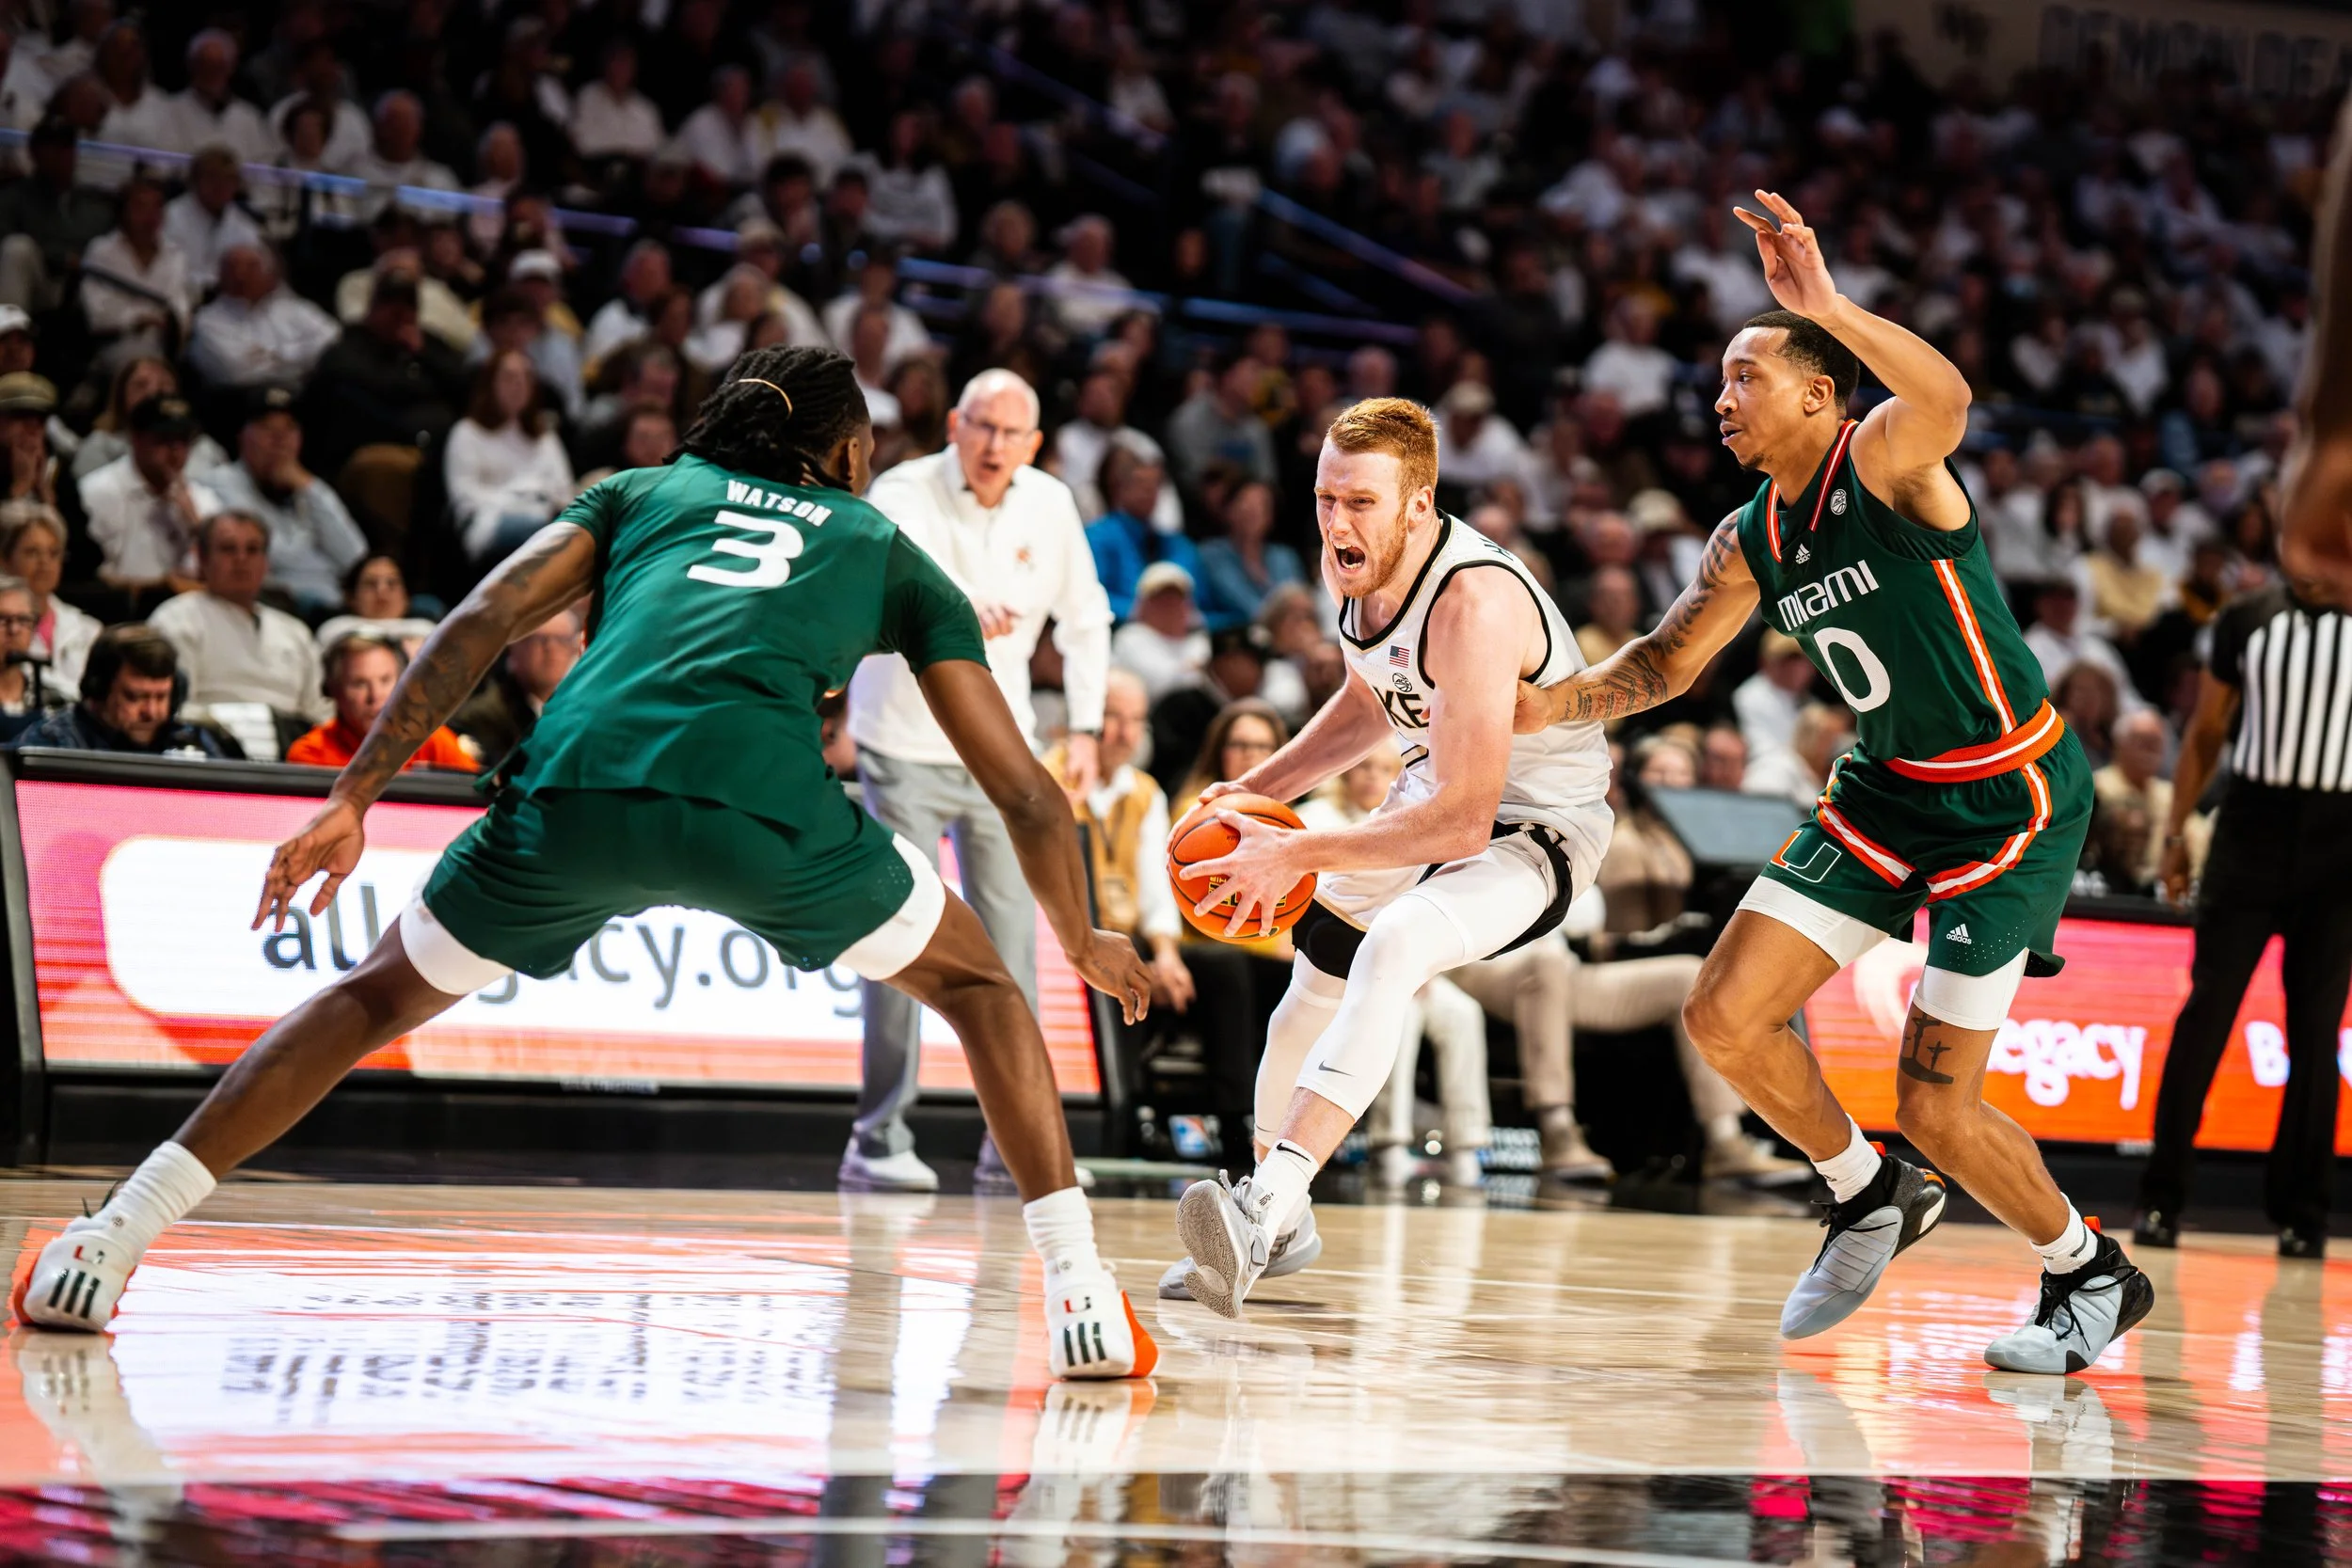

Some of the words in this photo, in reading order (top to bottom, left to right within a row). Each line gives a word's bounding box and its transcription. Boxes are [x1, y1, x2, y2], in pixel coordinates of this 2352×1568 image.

[726, 479, 833, 527] WATSON
[687, 510, 804, 588] 3
[1813, 626, 1891, 713] 0
[1946, 933, 1972, 945] adidas
